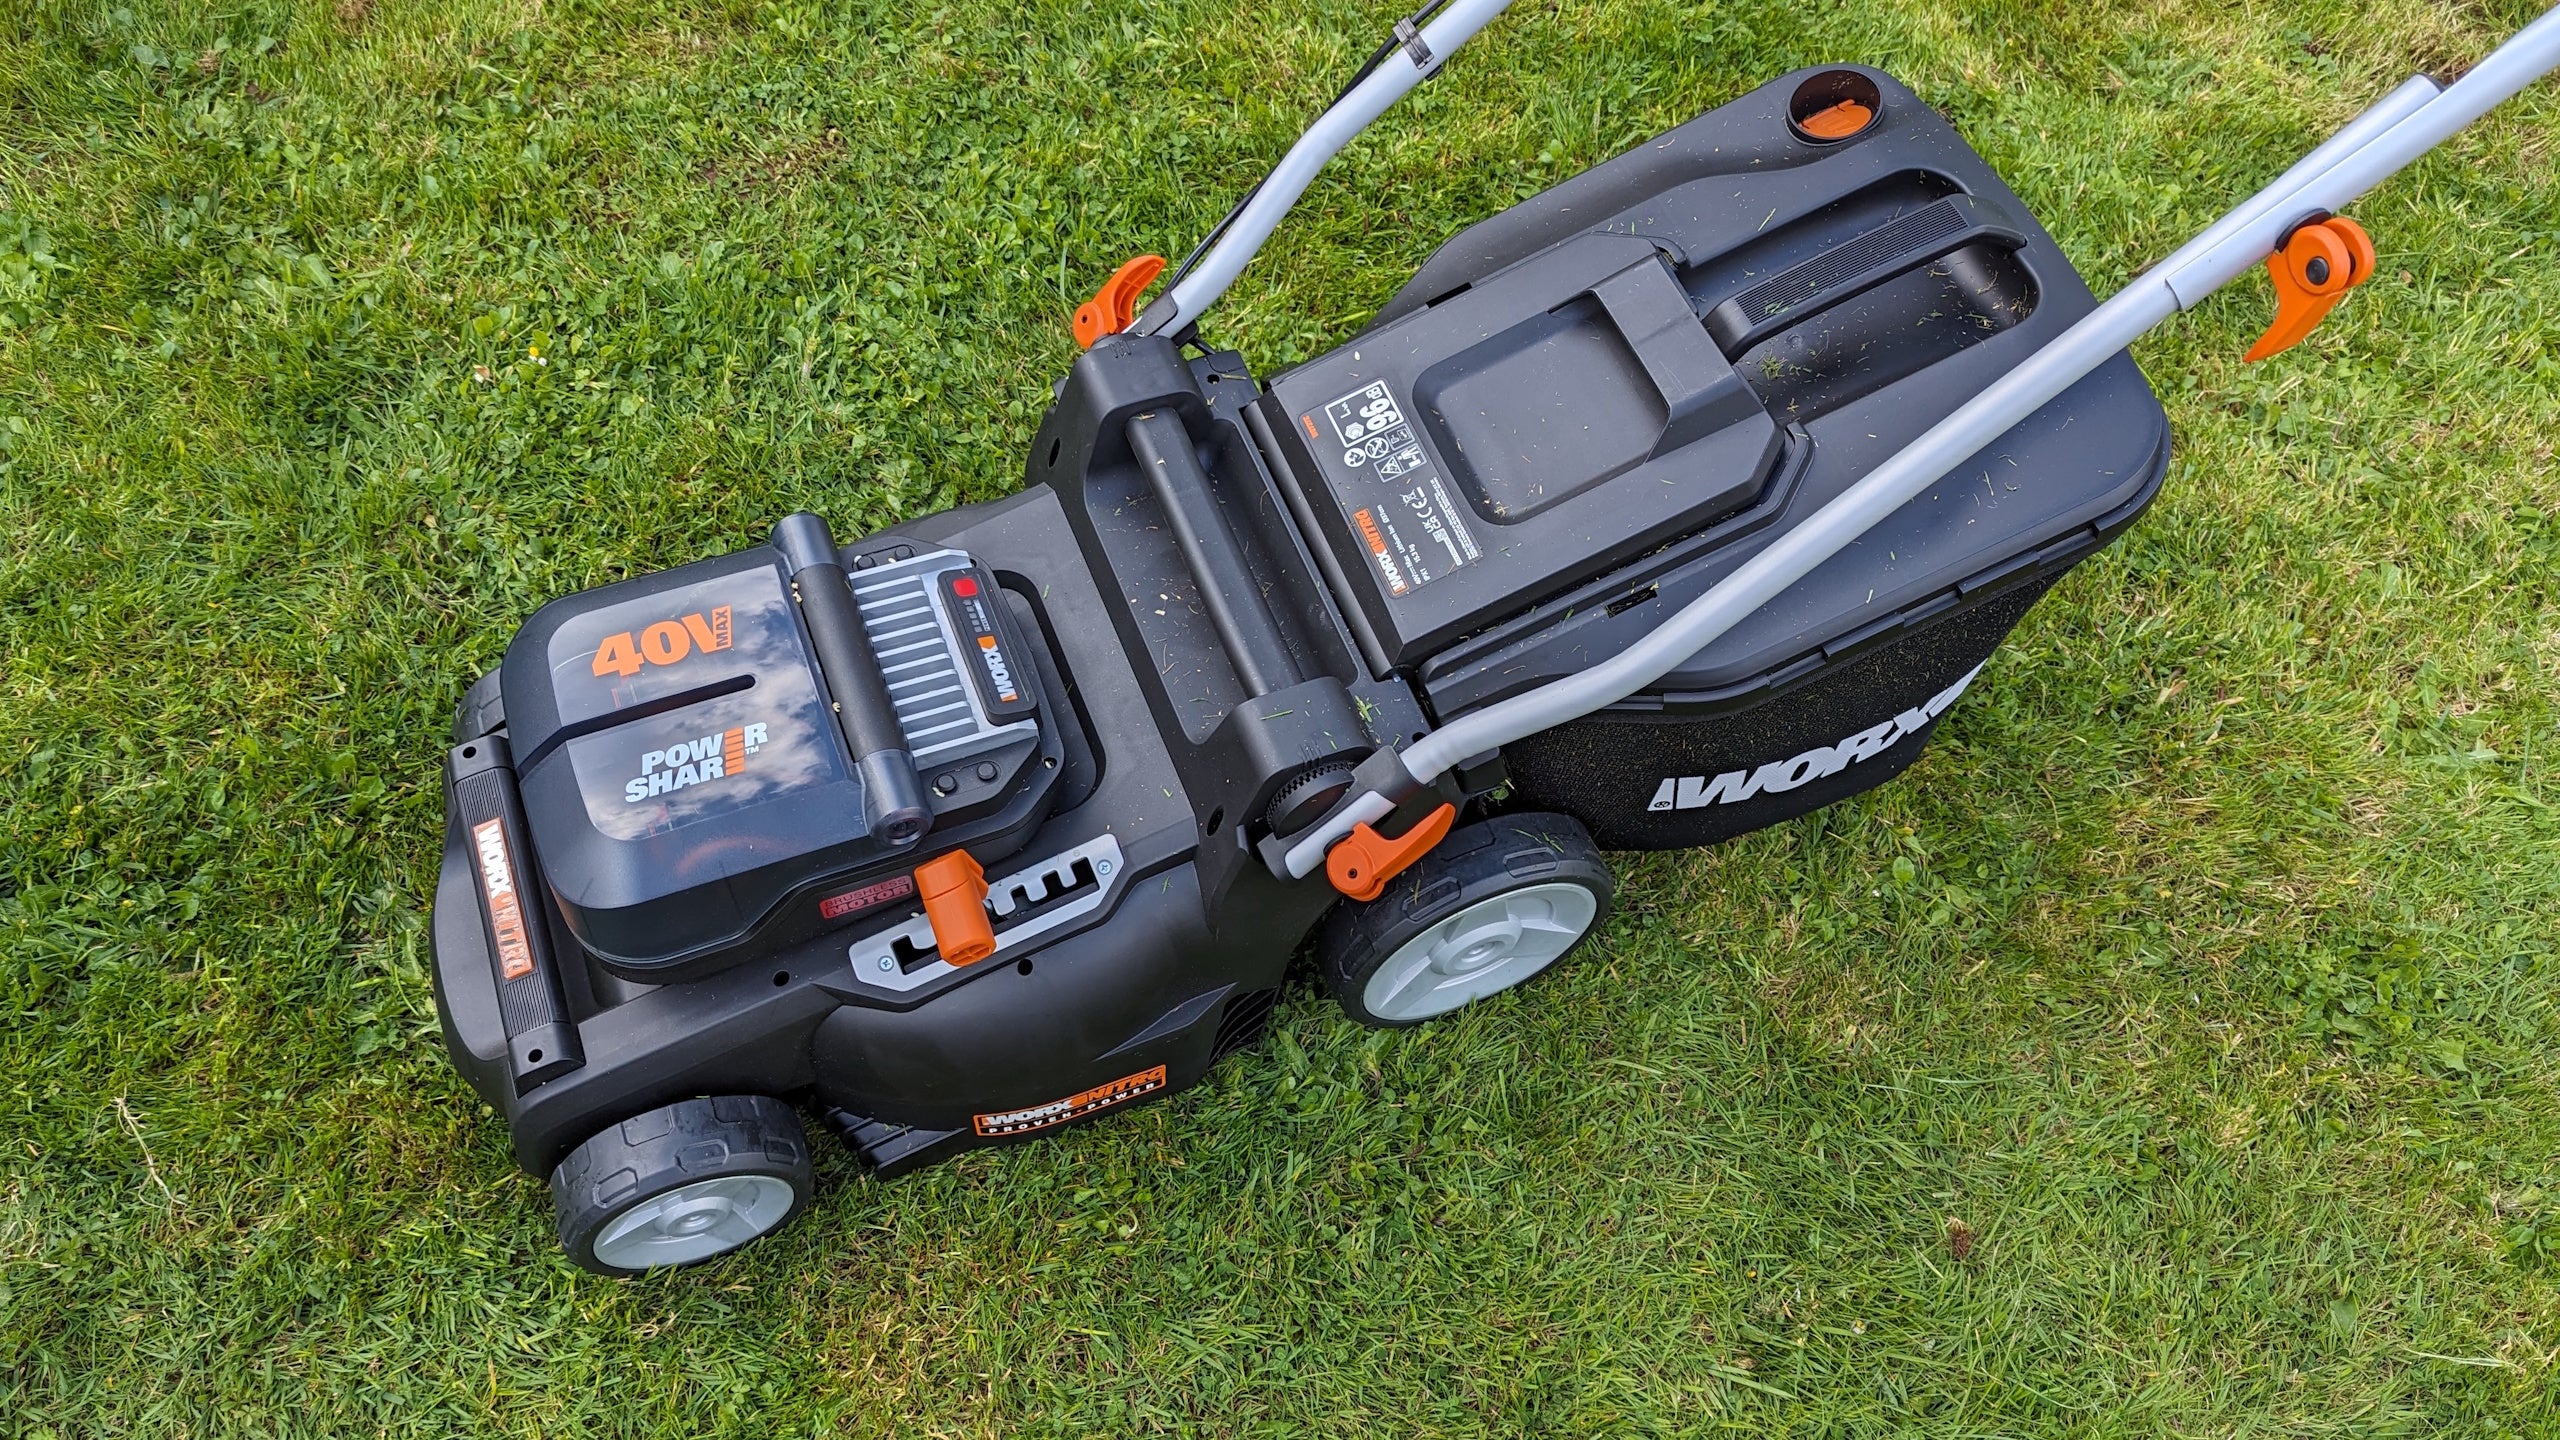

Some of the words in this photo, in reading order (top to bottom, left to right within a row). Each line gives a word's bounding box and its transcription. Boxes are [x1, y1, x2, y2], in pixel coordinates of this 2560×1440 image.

[1365, 385, 1382, 400] dB
[1360, 397, 1398, 431] 96
[1411, 496, 1434, 520] CE
[1429, 514, 1441, 529] CA
[1355, 510, 1382, 547] NITRO
[1386, 524, 1395, 534] Ion
[1391, 533, 1405, 553] Lithium
[1422, 519, 1434, 533] UK
[1407, 542, 1416, 552] kg
[1411, 550, 1421, 563] 15.3
[1376, 550, 1404, 590] WORX
[1420, 567, 1430, 581] IPX1
[591, 604, 732, 677] 40V
[716, 609, 729, 648] MAX
[981, 643, 1016, 700] WORX
[641, 721, 768, 777] POWER
[1660, 692, 1945, 811] WORX
[477, 822, 513, 900] WORX
[823, 877, 908, 907] BRUSHLESS
[825, 884, 911, 916] MOTOR
[494, 902, 527, 978] NITRO
[987, 1099, 1074, 1126] WORX
[1087, 1068, 1163, 1101] NITRO
[988, 1111, 1072, 1134] PROVEN
[1087, 1082, 1155, 1110] POWER
